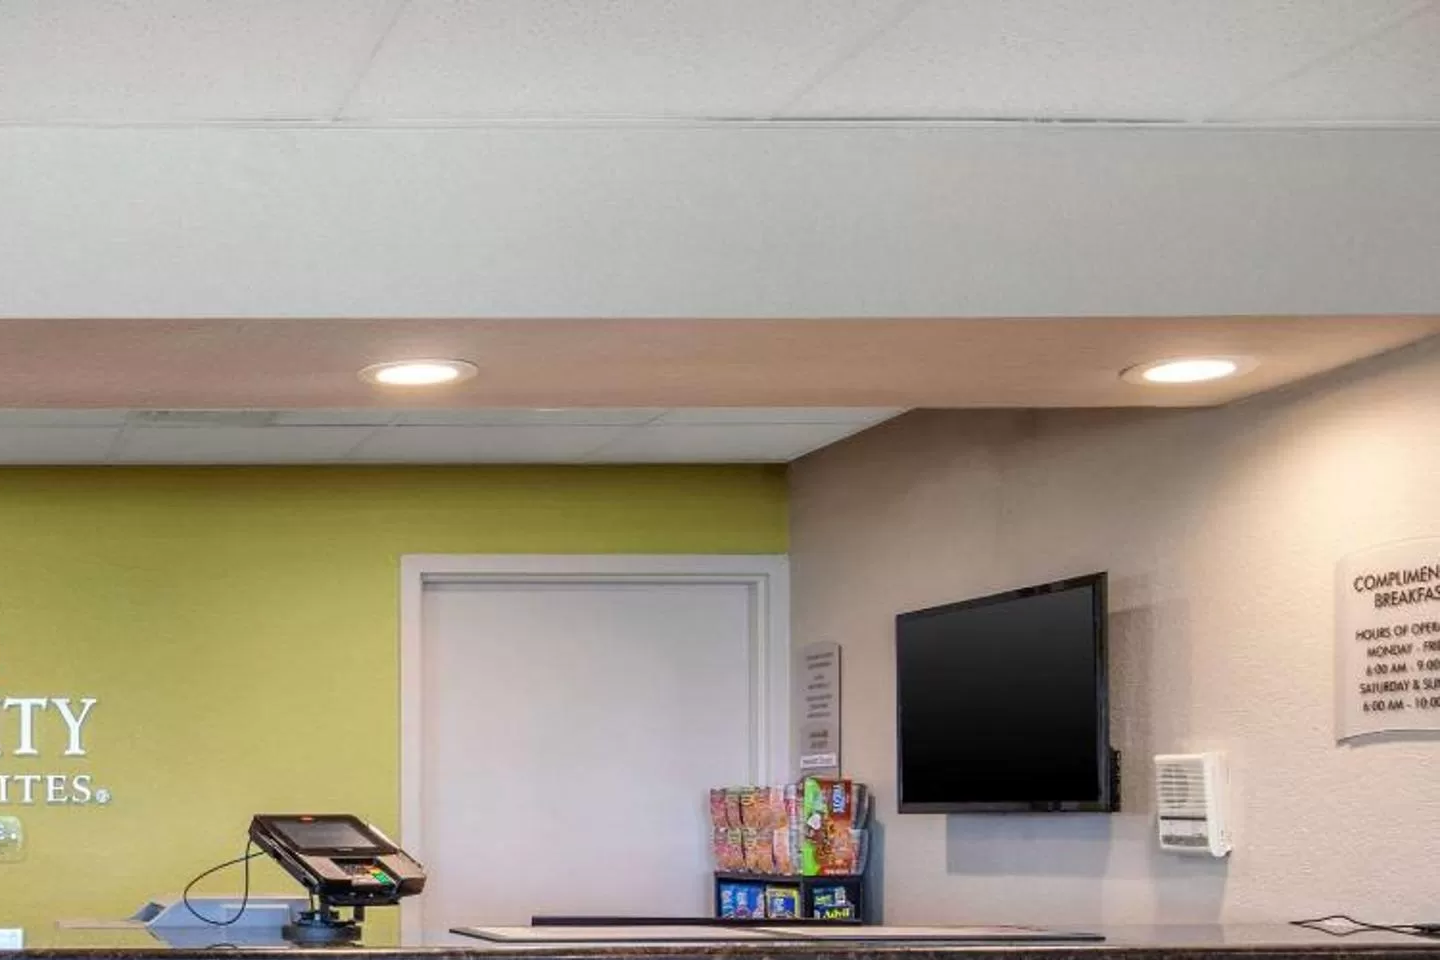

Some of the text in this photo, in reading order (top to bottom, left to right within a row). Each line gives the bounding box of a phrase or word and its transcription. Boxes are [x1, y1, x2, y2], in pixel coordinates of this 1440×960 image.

[1353, 564, 1440, 592] COMPLIMEN
[1356, 627, 1391, 641] HOURS
[1393, 624, 1408, 637] OF
[1367, 643, 1413, 657] MONDAY
[1390, 662, 1408, 673] AM
[1359, 679, 1410, 694] SATURDAY
[1387, 699, 1405, 711] AM
